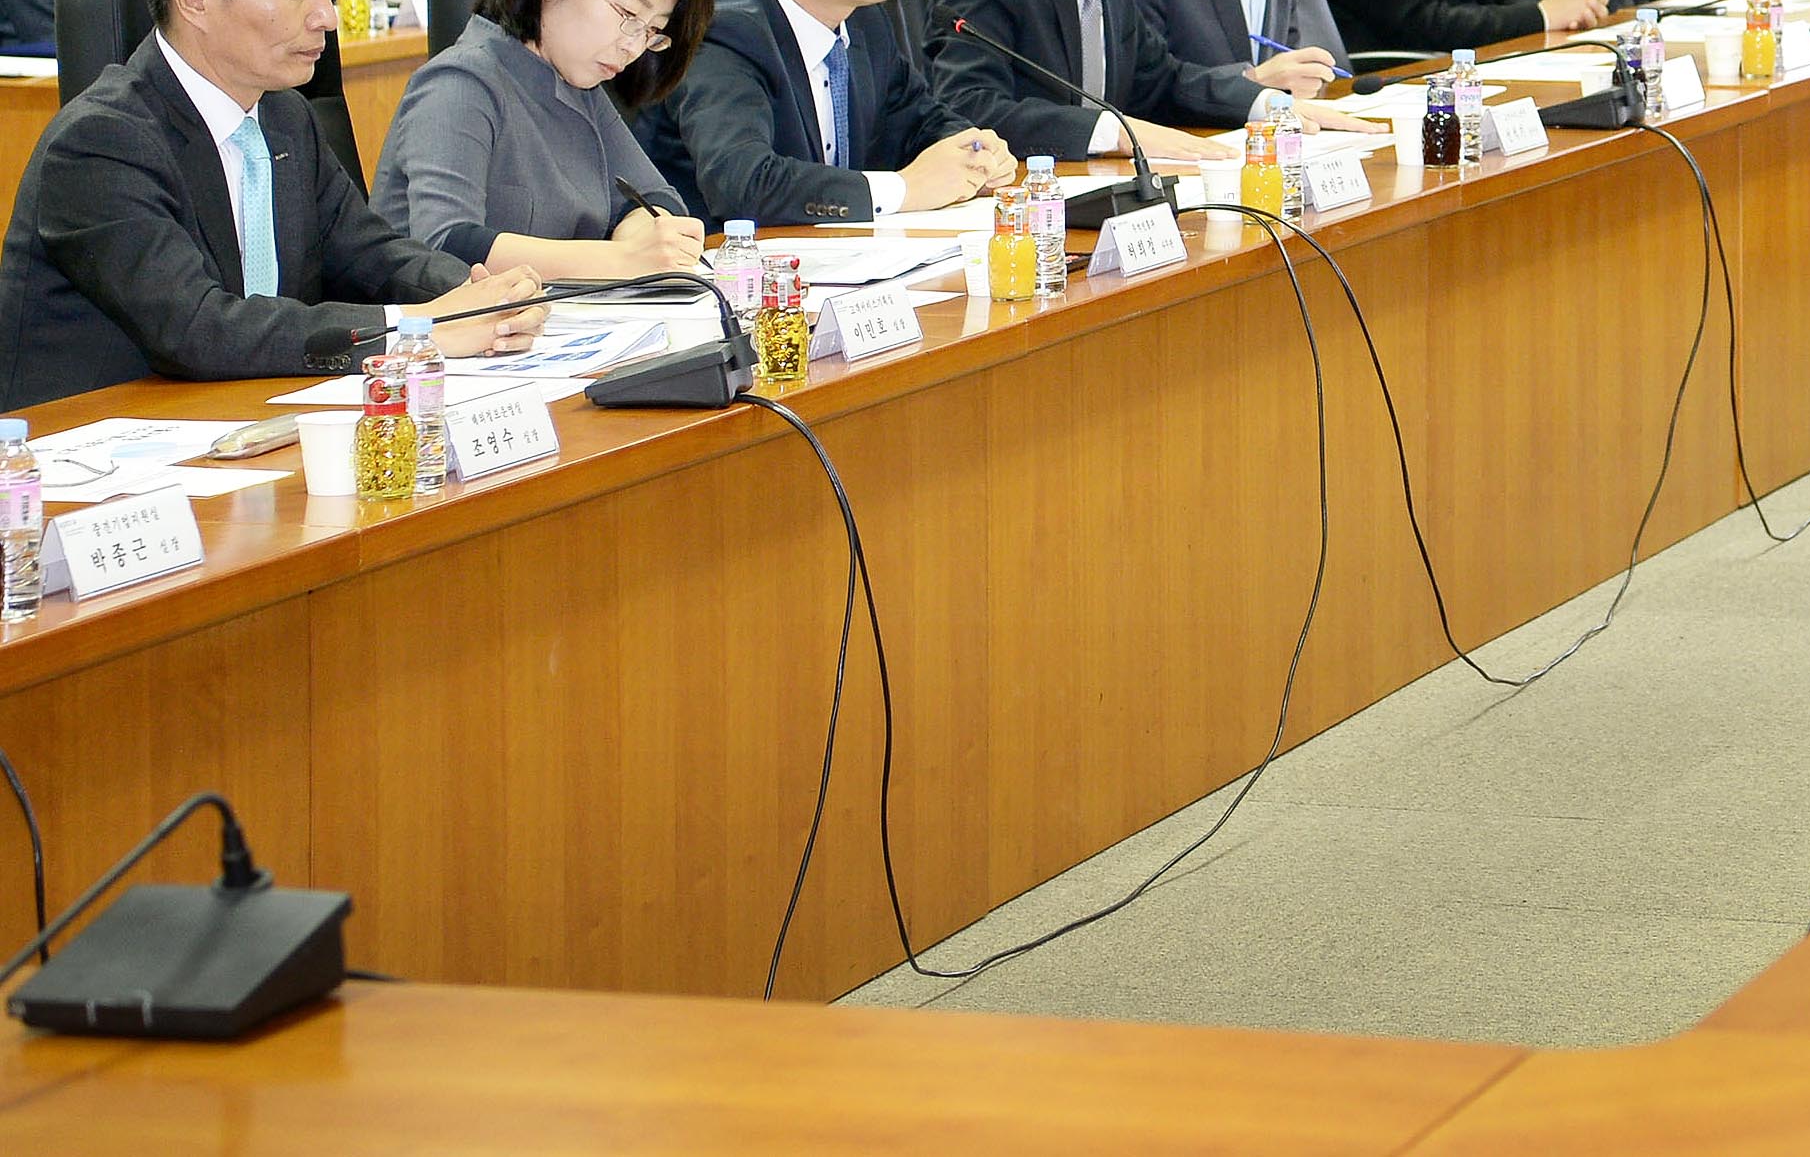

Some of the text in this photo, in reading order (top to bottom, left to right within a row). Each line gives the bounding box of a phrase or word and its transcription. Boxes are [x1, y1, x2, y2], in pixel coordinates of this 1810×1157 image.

[853, 317, 888, 342] 이민호
[471, 427, 515, 458] 조영수
[90, 537, 149, 574] 박종근
